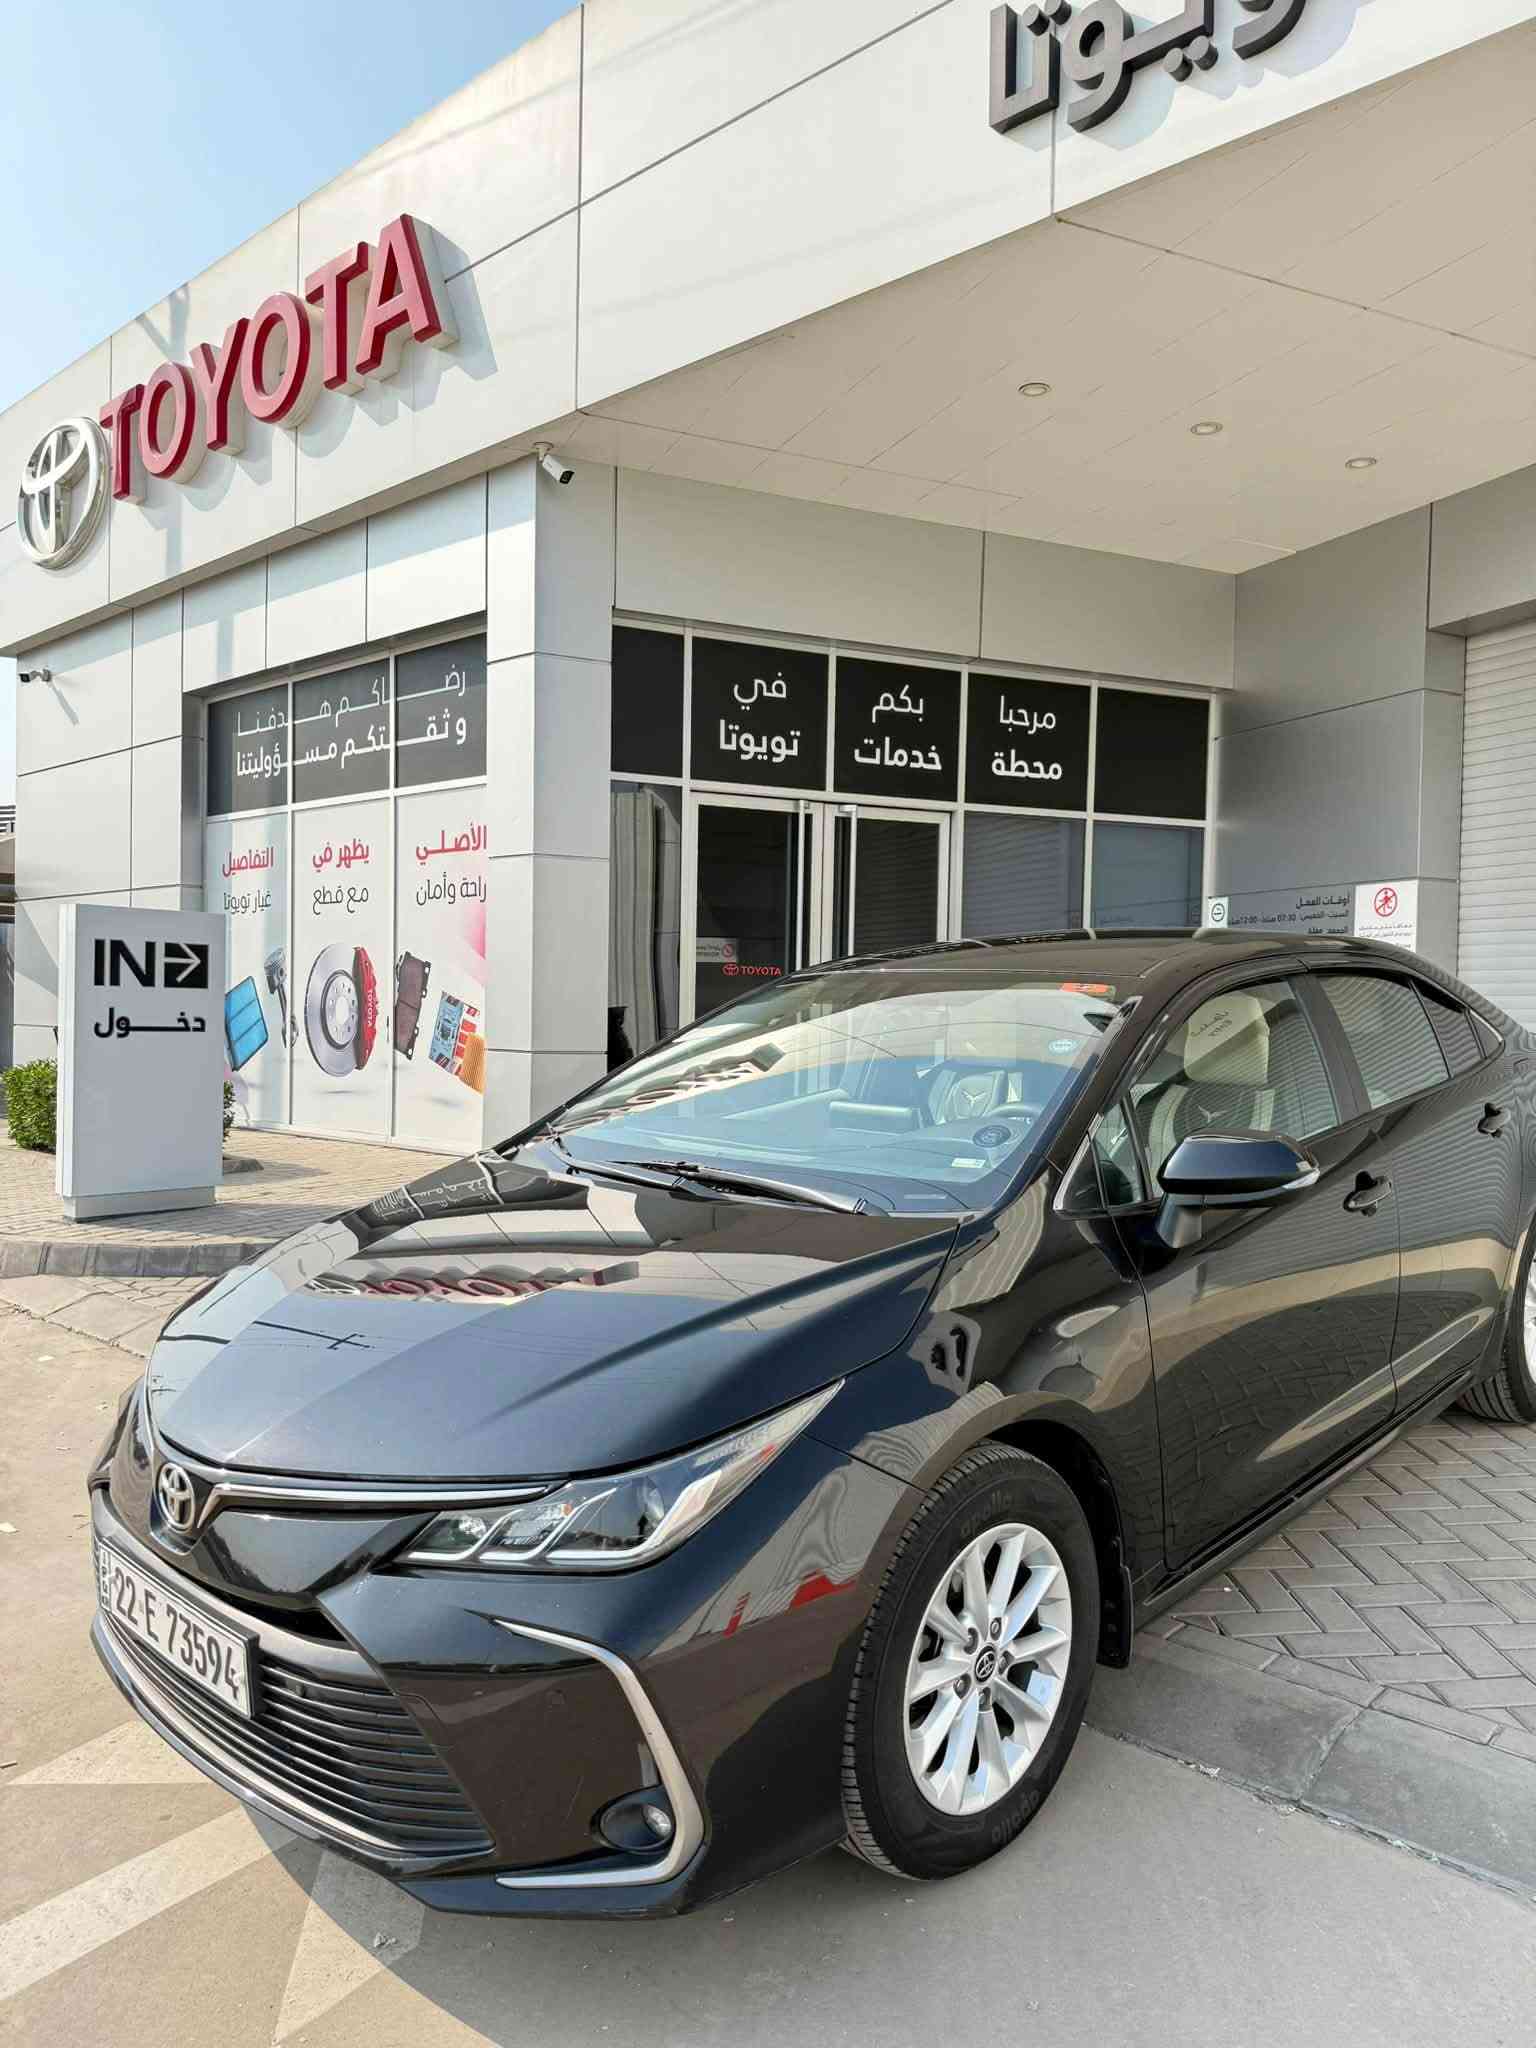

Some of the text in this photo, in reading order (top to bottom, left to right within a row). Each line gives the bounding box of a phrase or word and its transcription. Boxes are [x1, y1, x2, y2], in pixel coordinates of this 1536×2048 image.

[99, 214, 442, 502] TOYOTA
[733, 671, 1057, 735] مرحبا بكم في
[718, 719, 1063, 782] محطة خدمات تويوتا
[221, 825, 488, 878] الأصلي يظهر في التفاصيل
[222, 893, 253, 915] تويوتا
[311, 886, 344, 916] قطع
[346, 887, 370, 912] مع
[415, 871, 457, 906] وأمان
[460, 877, 488, 902] راحة
[94, 939, 156, 988] IN
[740, 966, 782, 977] TOYOTA
[94, 1007, 207, 1038] دخول
[115, 1566, 139, 1626] 22
[144, 1589, 160, 1642] E
[166, 1604, 240, 1700] 73594
